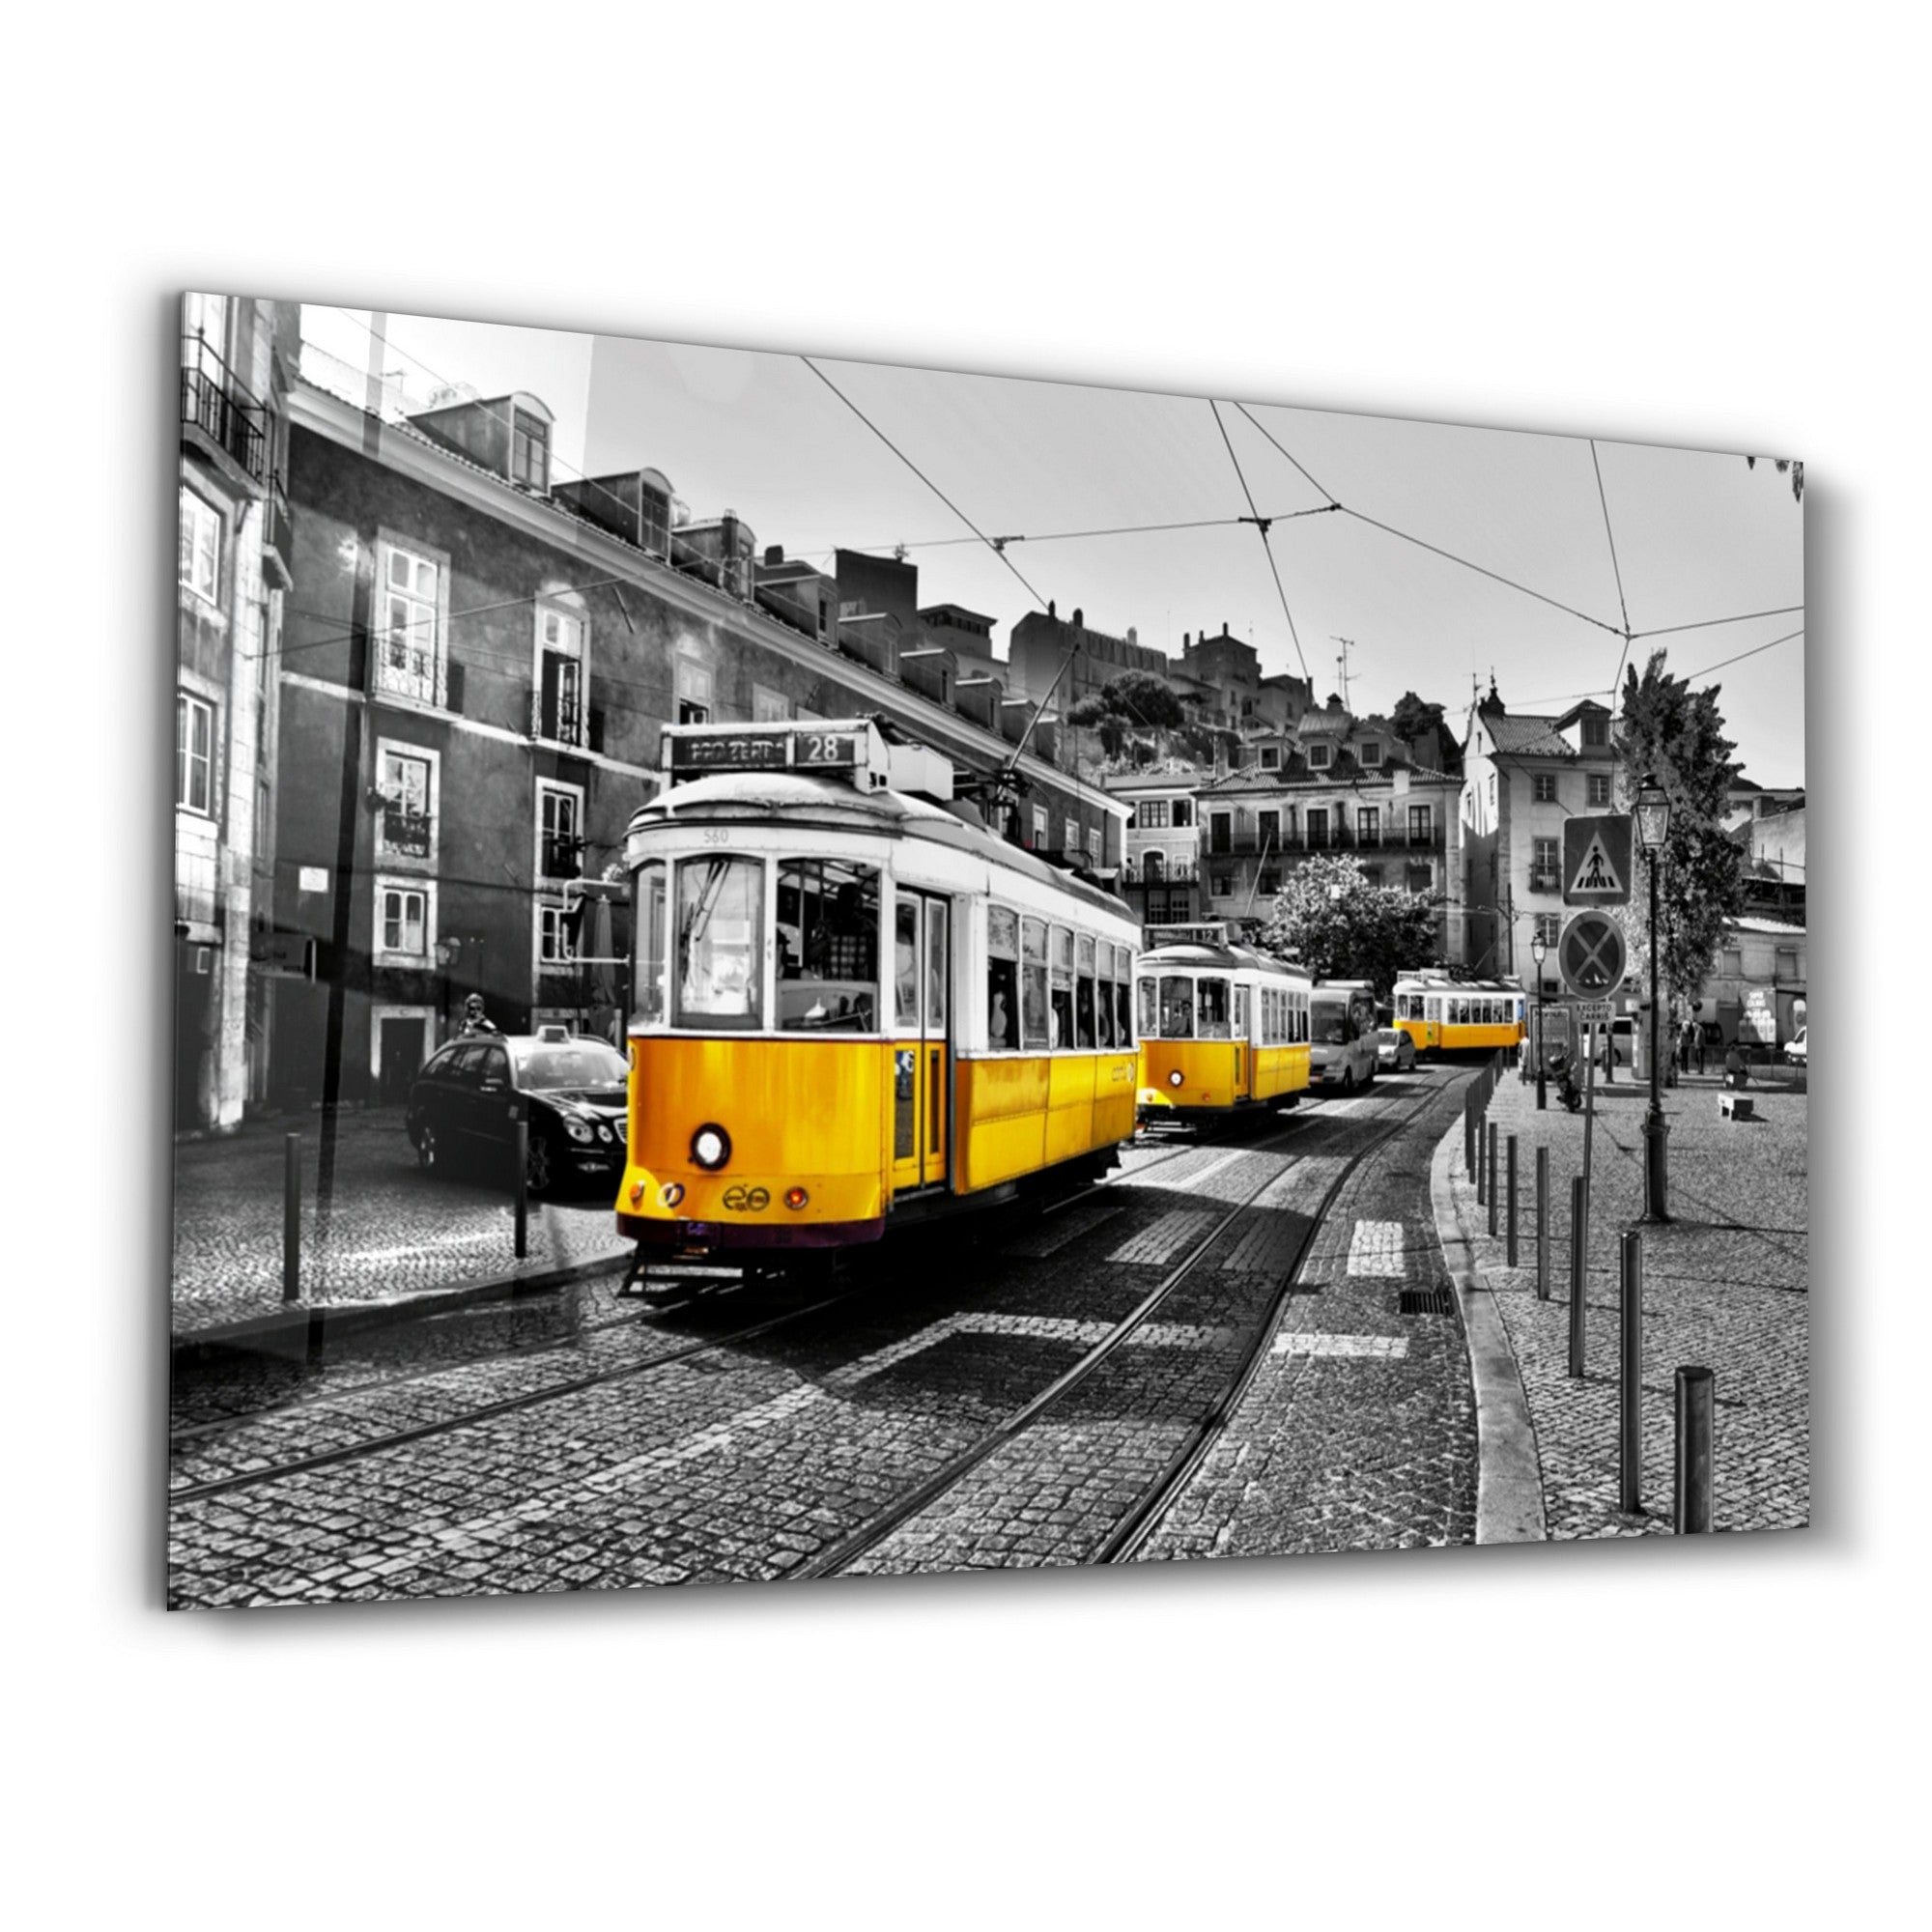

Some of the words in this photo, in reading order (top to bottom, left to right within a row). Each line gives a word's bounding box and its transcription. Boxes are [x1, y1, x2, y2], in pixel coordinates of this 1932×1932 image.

[808, 737, 838, 761] 28
[703, 829, 729, 844] 560
[1203, 930, 1214, 943] 12
[1577, 1004, 1612, 1012] EXCEPTO
